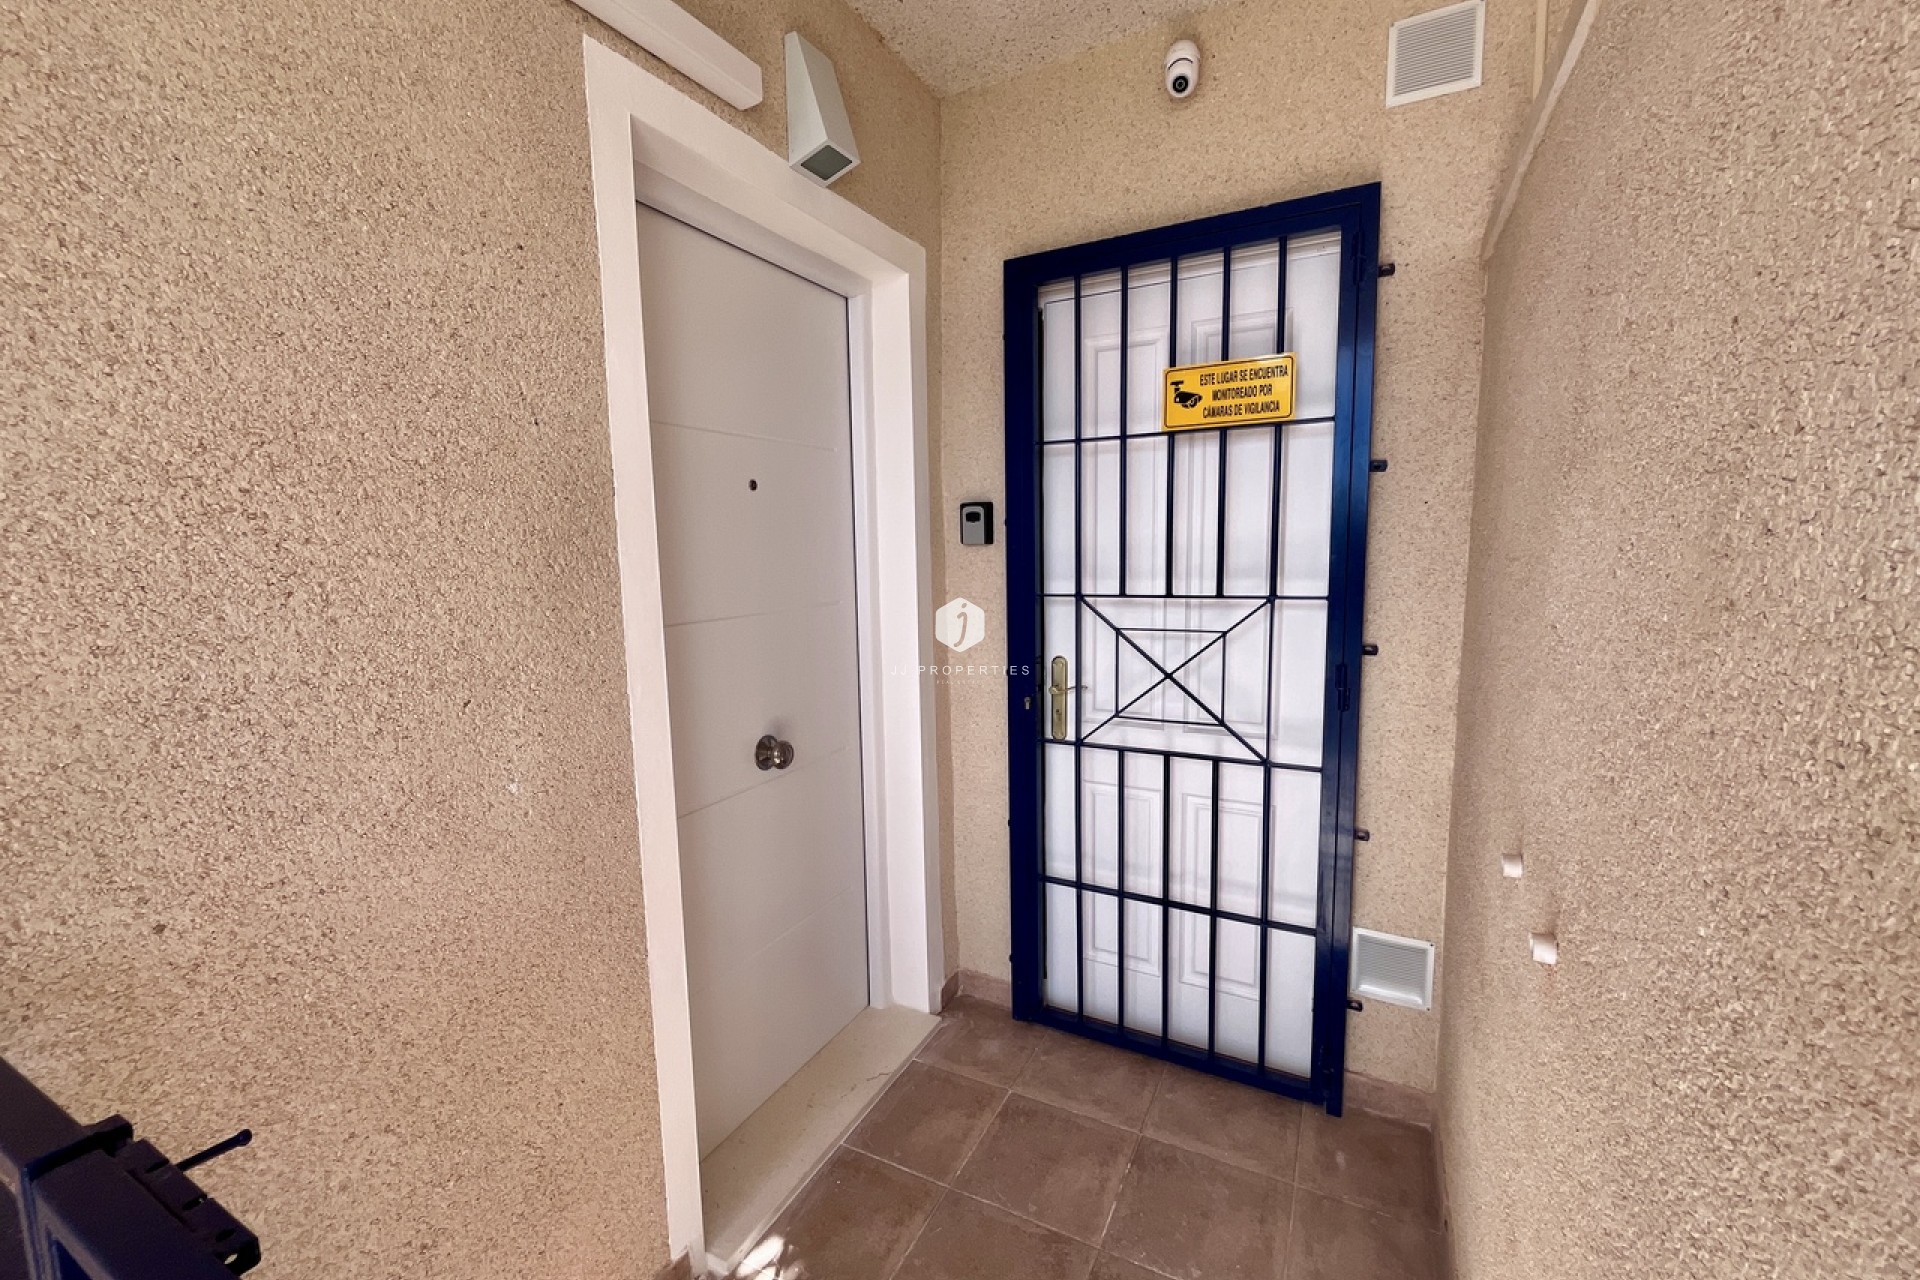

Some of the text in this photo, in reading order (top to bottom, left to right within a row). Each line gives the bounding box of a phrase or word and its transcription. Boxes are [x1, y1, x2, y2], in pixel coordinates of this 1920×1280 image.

[1199, 364, 1289, 386] ESTE LUGAR SE ENCUENTRA
[1211, 383, 1273, 401] MONITOREADO POR
[1234, 403, 1243, 415] DE
[1244, 400, 1280, 415] VIGILANCIA
